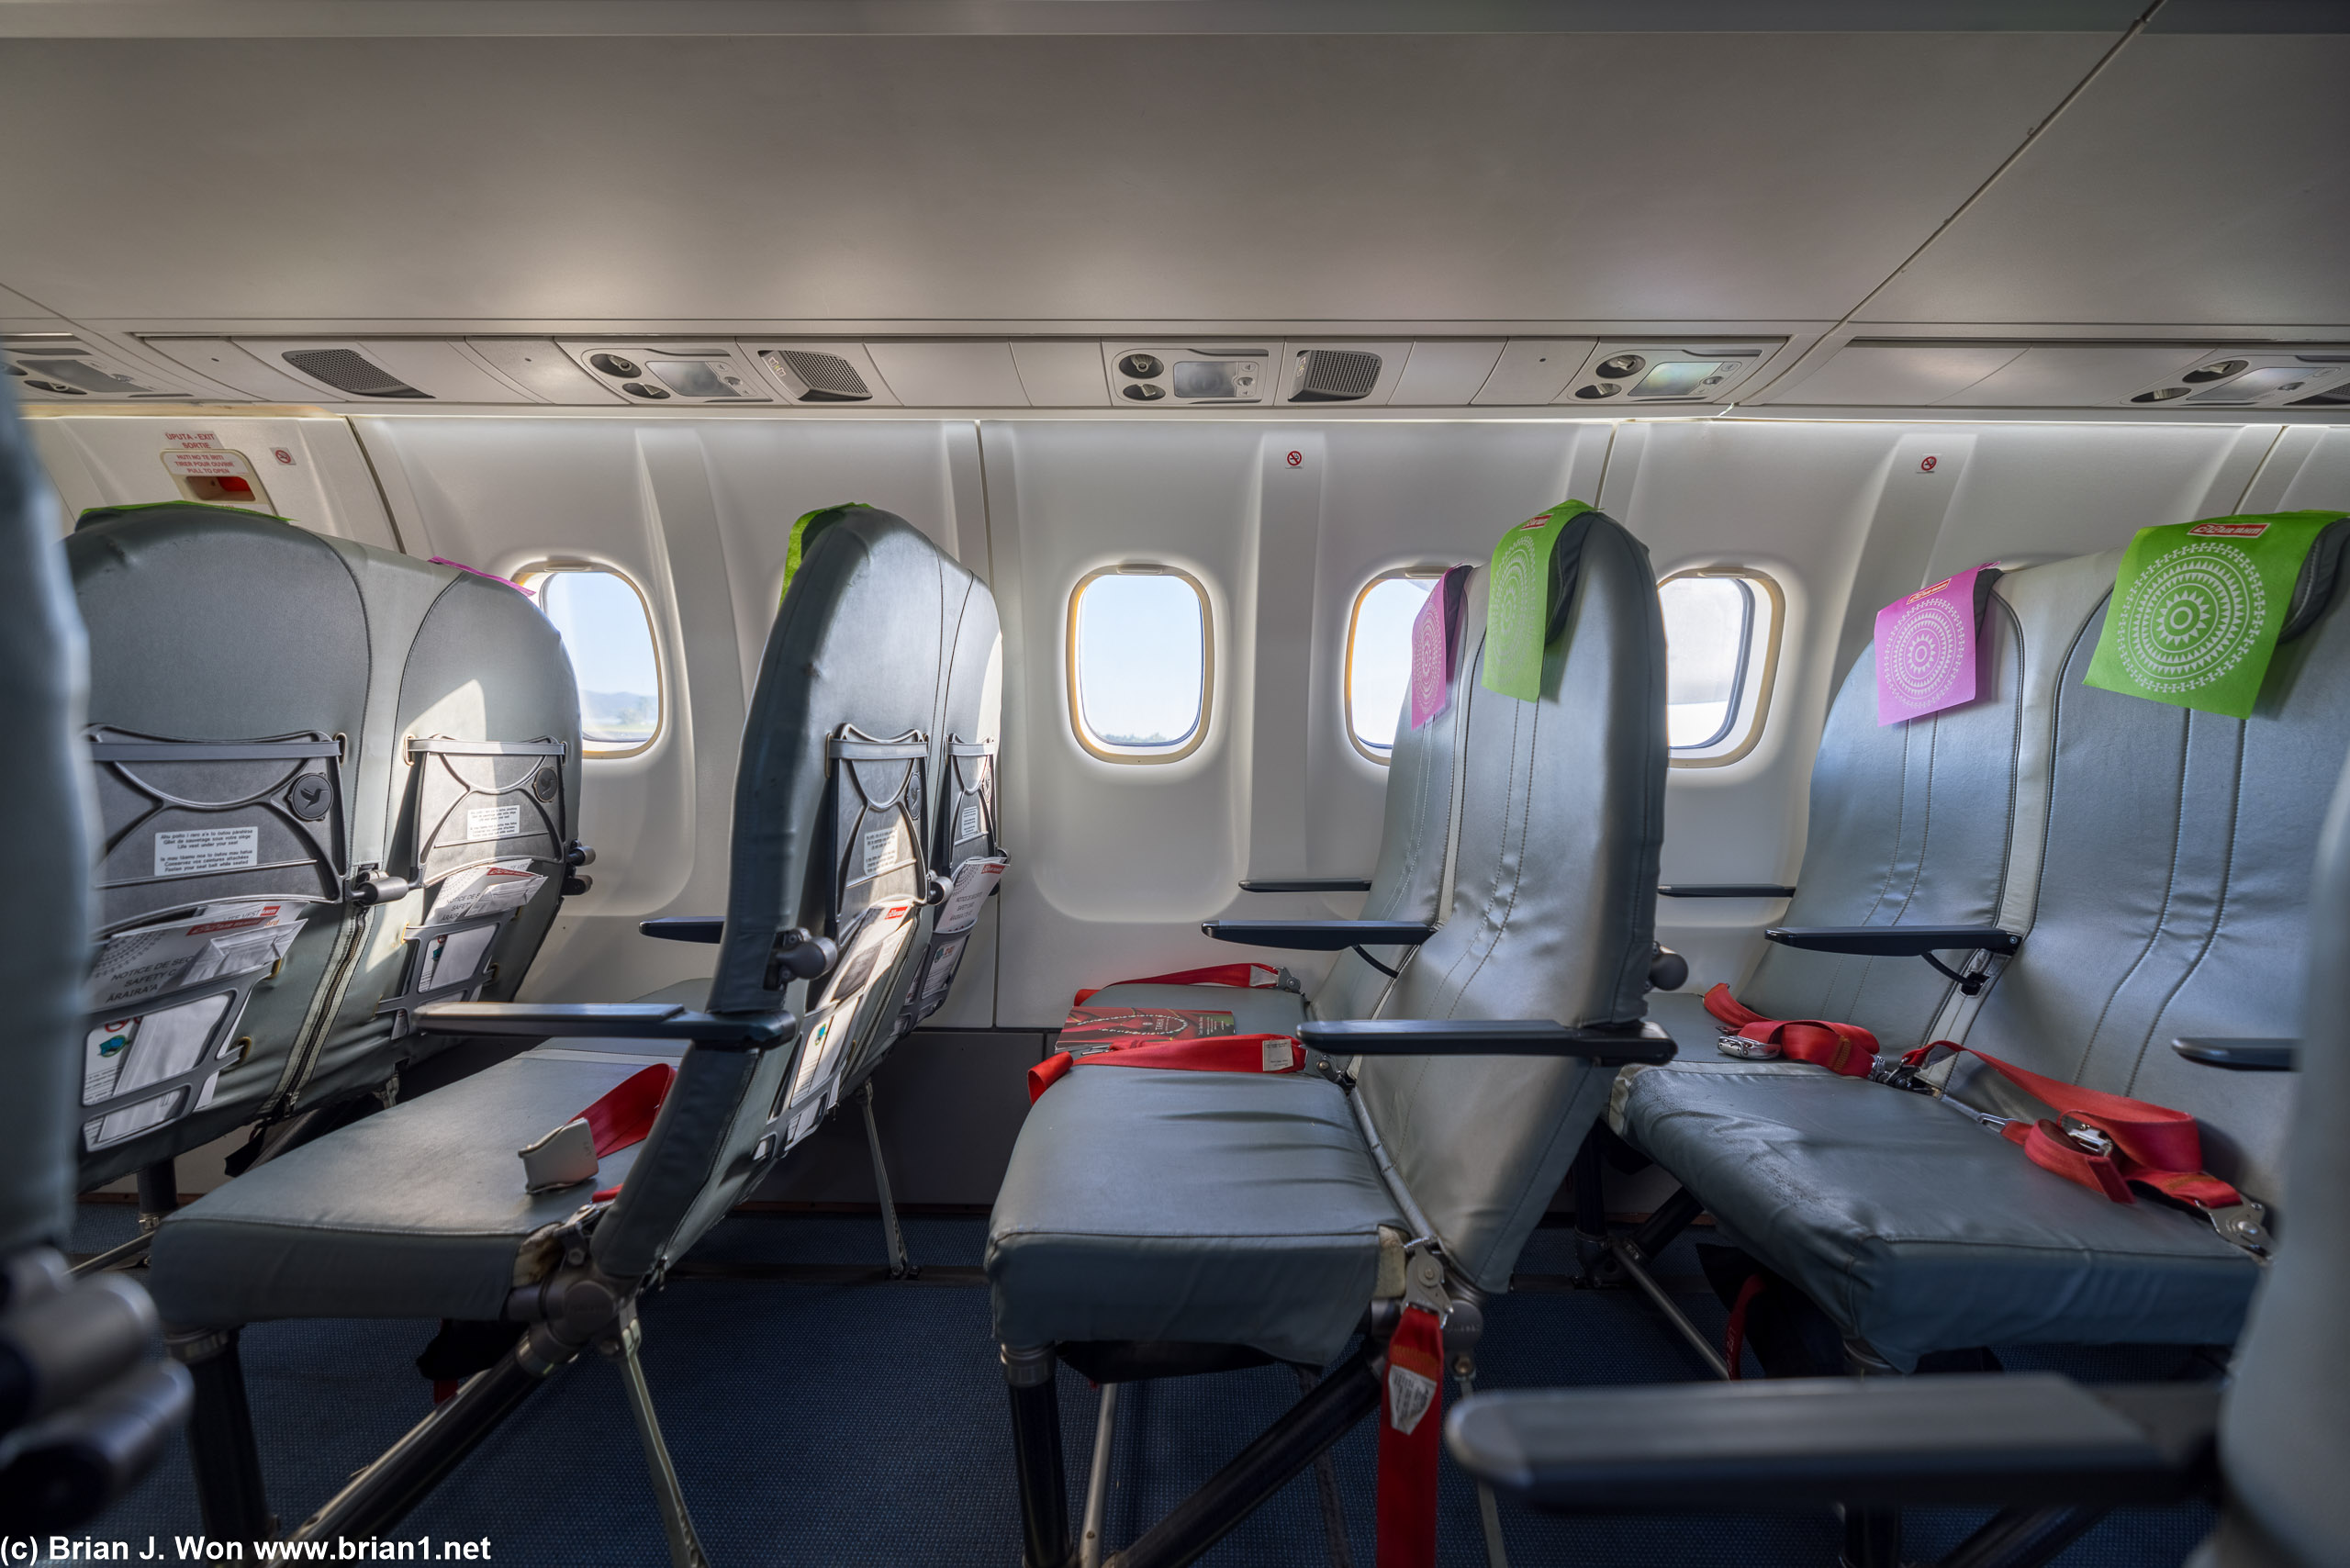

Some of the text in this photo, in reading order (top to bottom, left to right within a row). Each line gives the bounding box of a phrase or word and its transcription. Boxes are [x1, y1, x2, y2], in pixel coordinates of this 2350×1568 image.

[111, 964, 153, 981] NOTICE
[153, 960, 172, 970] DE
[124, 972, 165, 988] SAFETY
